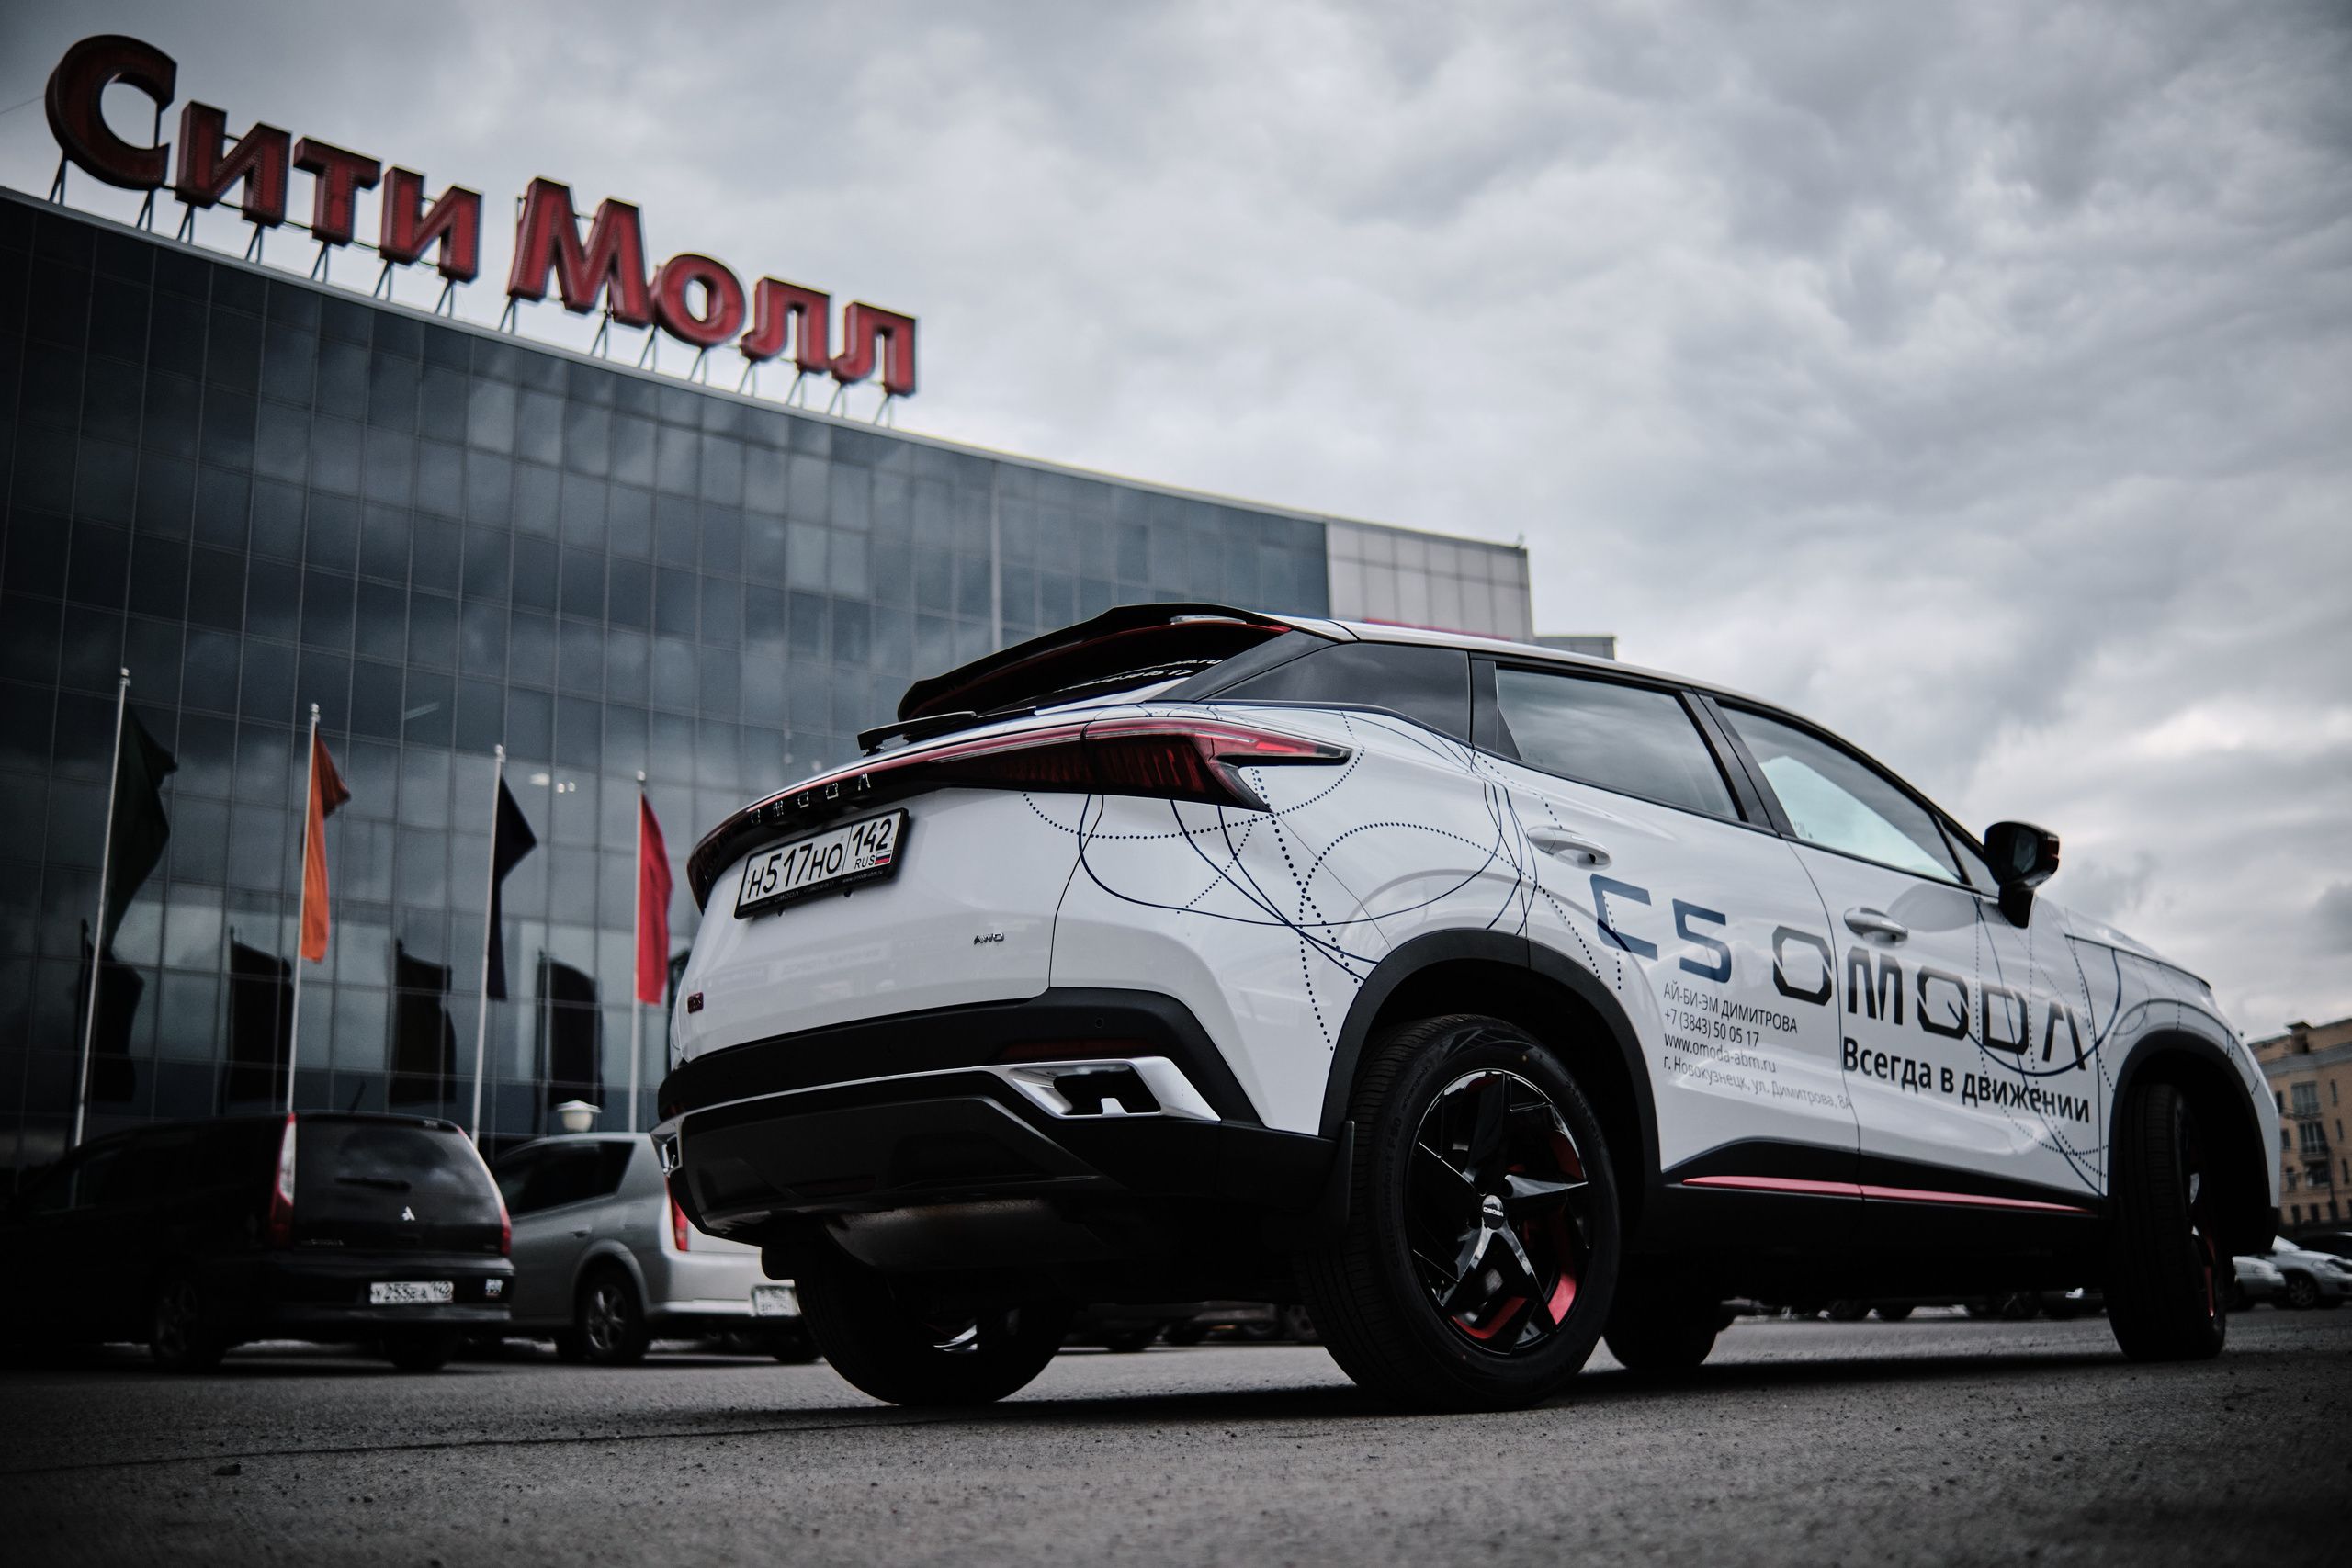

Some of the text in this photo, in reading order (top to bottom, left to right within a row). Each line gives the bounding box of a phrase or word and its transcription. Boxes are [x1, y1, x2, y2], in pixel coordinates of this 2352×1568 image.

[44, 33, 918, 398] Сити Молл
[852, 818, 893, 857] 142
[854, 854, 876, 870] RUS
[973, 931, 1005, 945] AWD
[1589, 873, 2086, 1071] C5 OMODA
[1664, 980, 1798, 1034] АЙ-БИ-ЭМ ДИМИТРОВА
[1665, 1009, 1759, 1048] +7 (3843) 50 05 17
[1664, 1032, 1777, 1074] www.omoda-abm.ru
[1663, 1055, 1671, 1070] г.
[1674, 1055, 1750, 1091] Новокузнецк,
[1751, 1077, 1770, 1095] ул.
[1771, 1079, 1838, 1110] Димитрова,
[1843, 1035, 2090, 1124] Всегда в движении
[1483, 1206, 1504, 1217] OMODA
